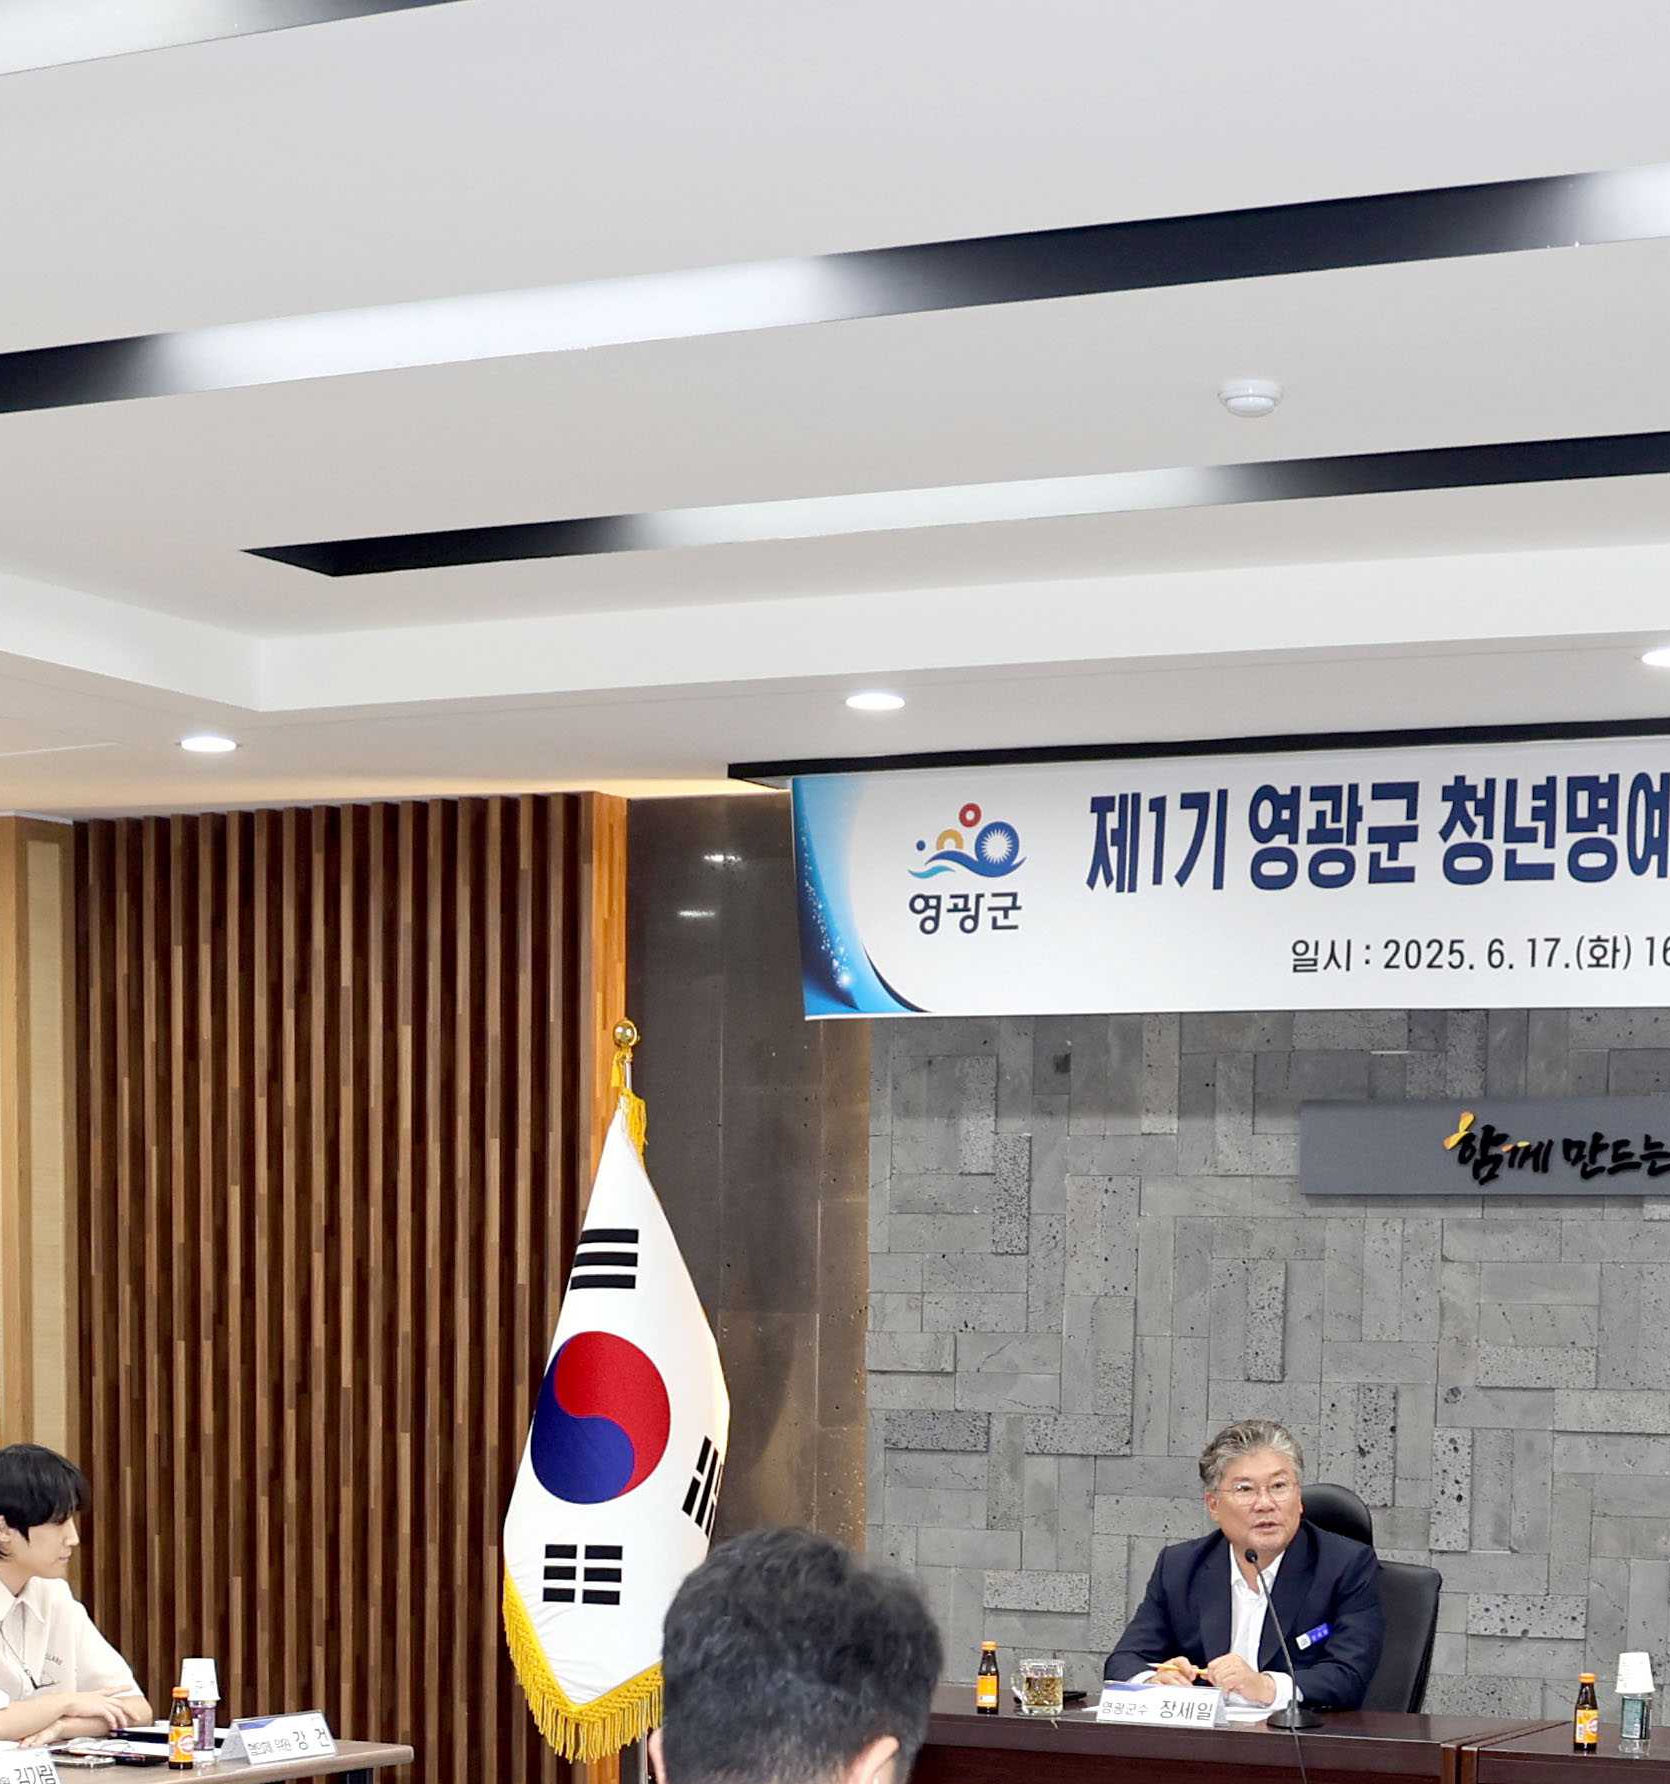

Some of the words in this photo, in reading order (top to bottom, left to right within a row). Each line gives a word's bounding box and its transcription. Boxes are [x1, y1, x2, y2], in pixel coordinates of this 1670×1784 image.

[1086, 788, 1229, 893] 제1기
[1248, 780, 1419, 890] 영광군
[908, 891, 1022, 935] 영광군
[1383, 938, 1474, 970] 2025.
[1487, 938, 1514, 970] 6.
[1442, 1111, 1553, 1186] 함께
[1101, 1700, 1150, 1717] 영광군수
[1159, 1699, 1214, 1721] 장세일
